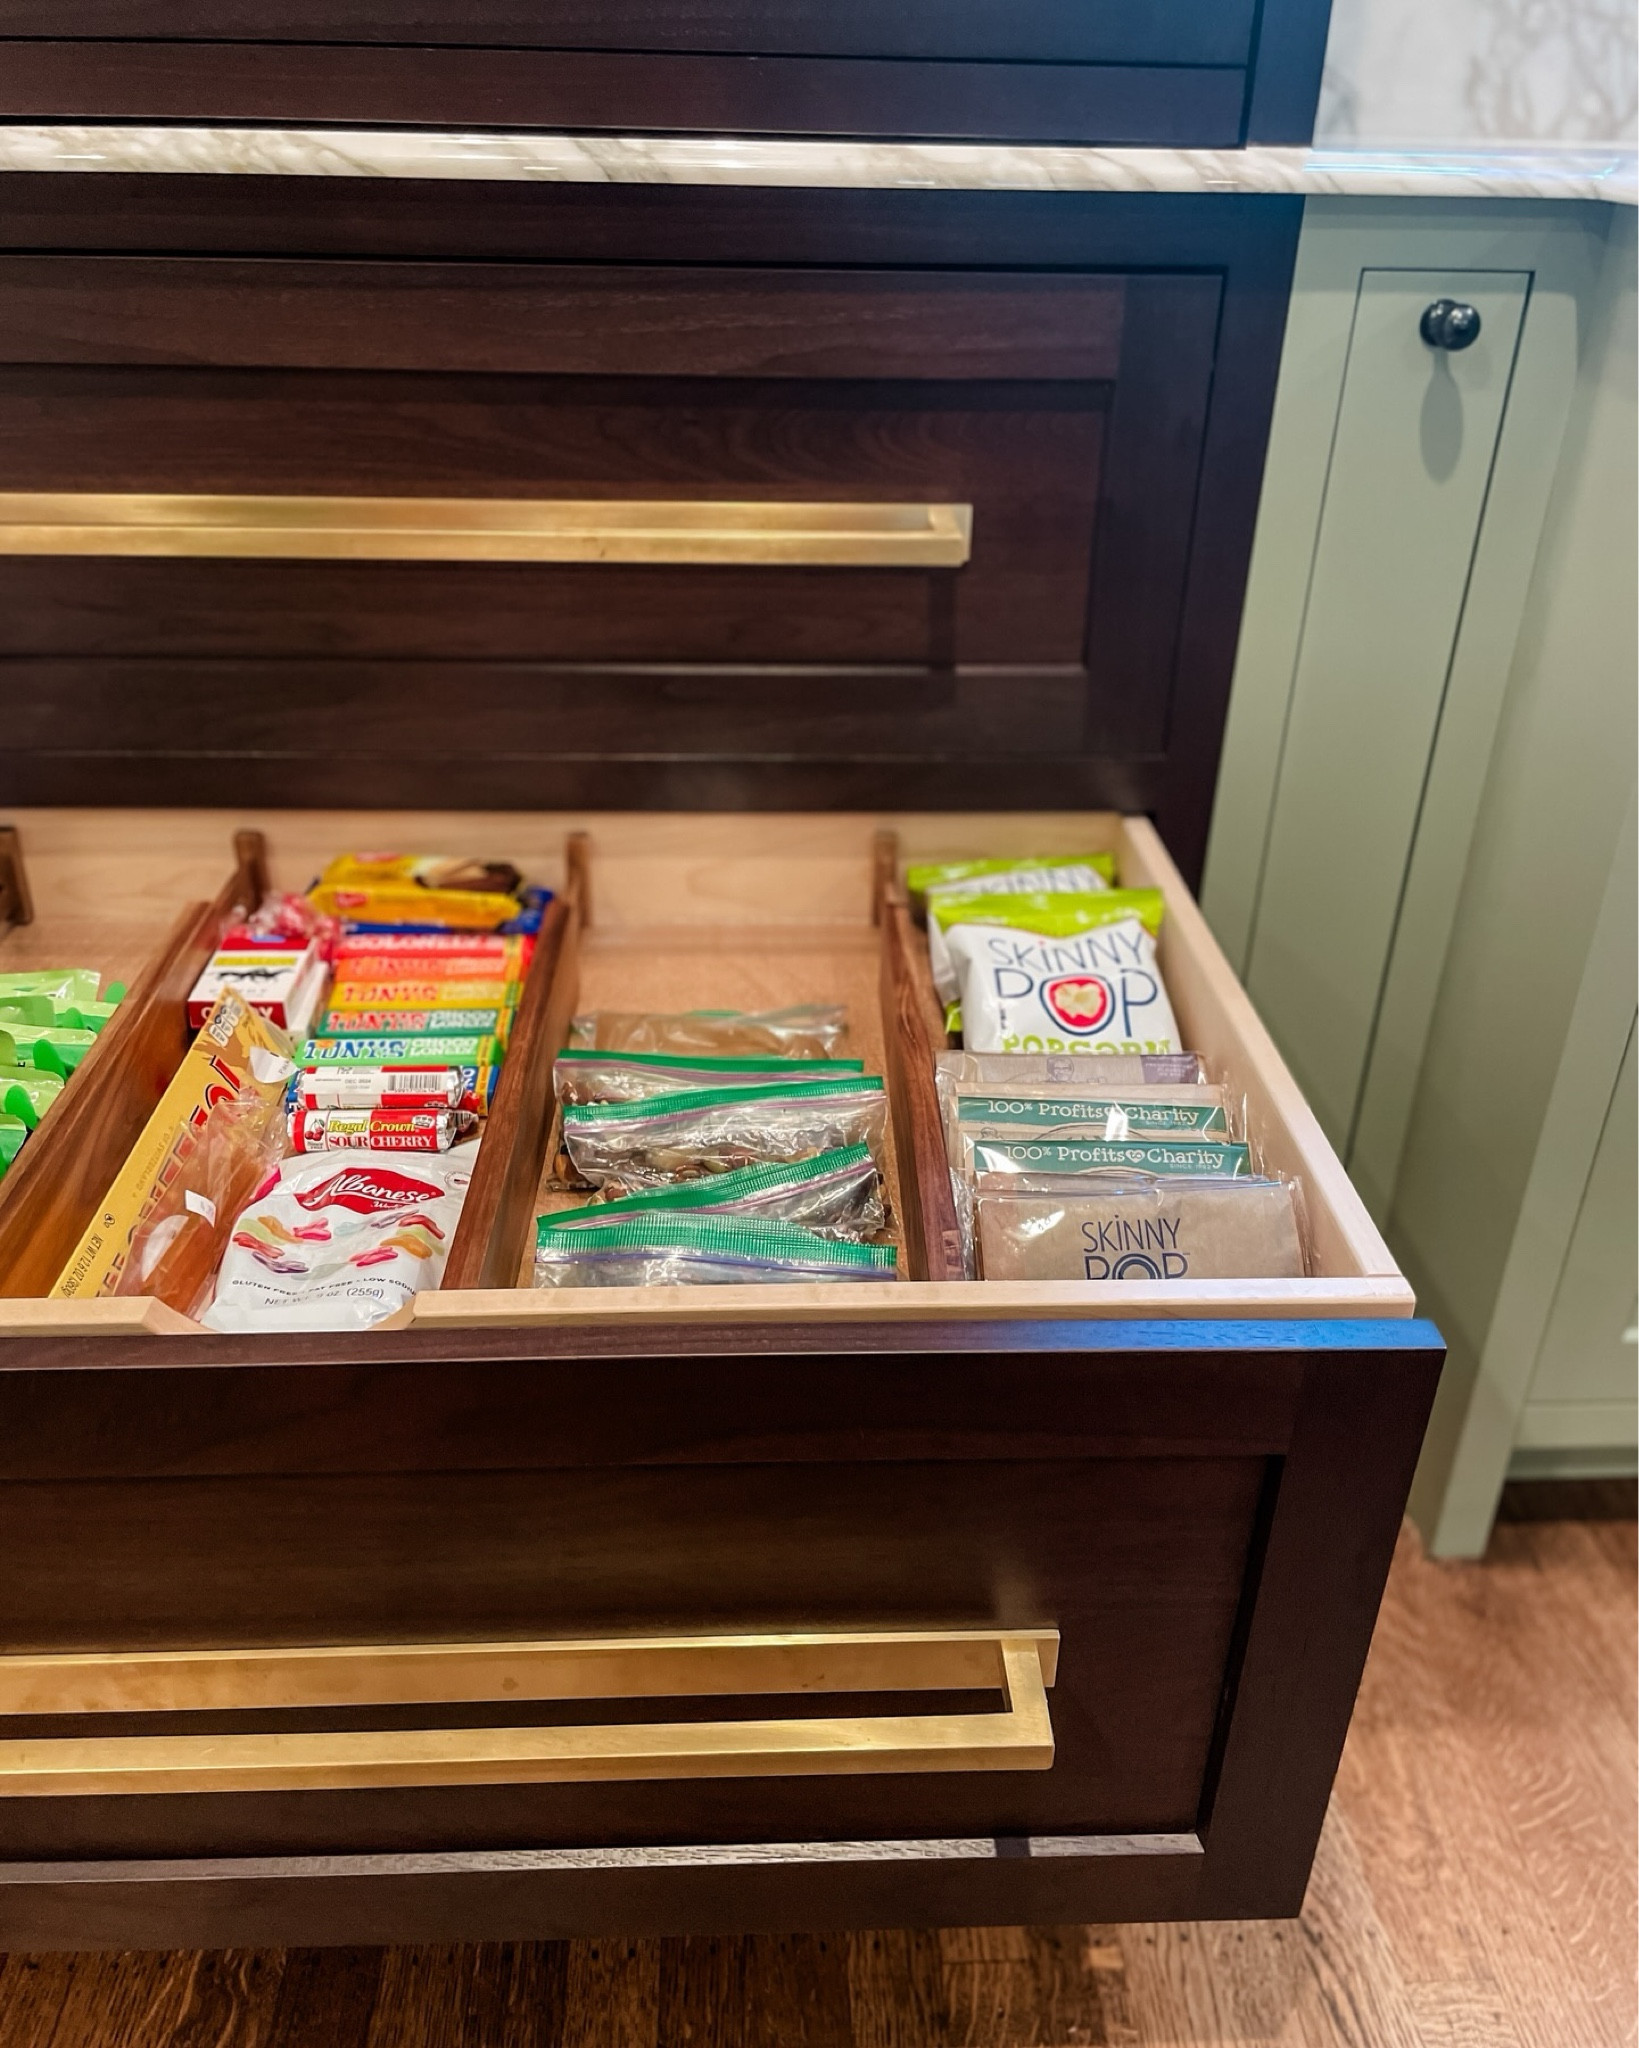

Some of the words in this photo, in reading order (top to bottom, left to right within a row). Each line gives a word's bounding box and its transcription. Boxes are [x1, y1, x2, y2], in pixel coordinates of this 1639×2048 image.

[987, 931, 1145, 972] SKINNY
[992, 967, 1159, 1038] POP
[304, 1039, 406, 1060] TONY'S
[988, 1100, 1033, 1114] 100%
[1038, 1103, 1103, 1119] Profits
[1126, 1106, 1199, 1125] Charity
[327, 1120, 368, 1135] Regal
[370, 1120, 415, 1133] Crown
[329, 1136, 368, 1148] SOUR
[370, 1135, 432, 1148] CHERRY
[1007, 1146, 1052, 1160] 100%
[1058, 1146, 1125, 1163] Profits
[1147, 1148, 1225, 1169] Charity
[303, 1174, 431, 1205] Albanese
[1081, 1215, 1181, 1253] SKINNY
[1084, 1252, 1188, 1279] POP
[232, 1279, 271, 1290] GLUTEN
[346, 1288, 384, 1300] (255g)
